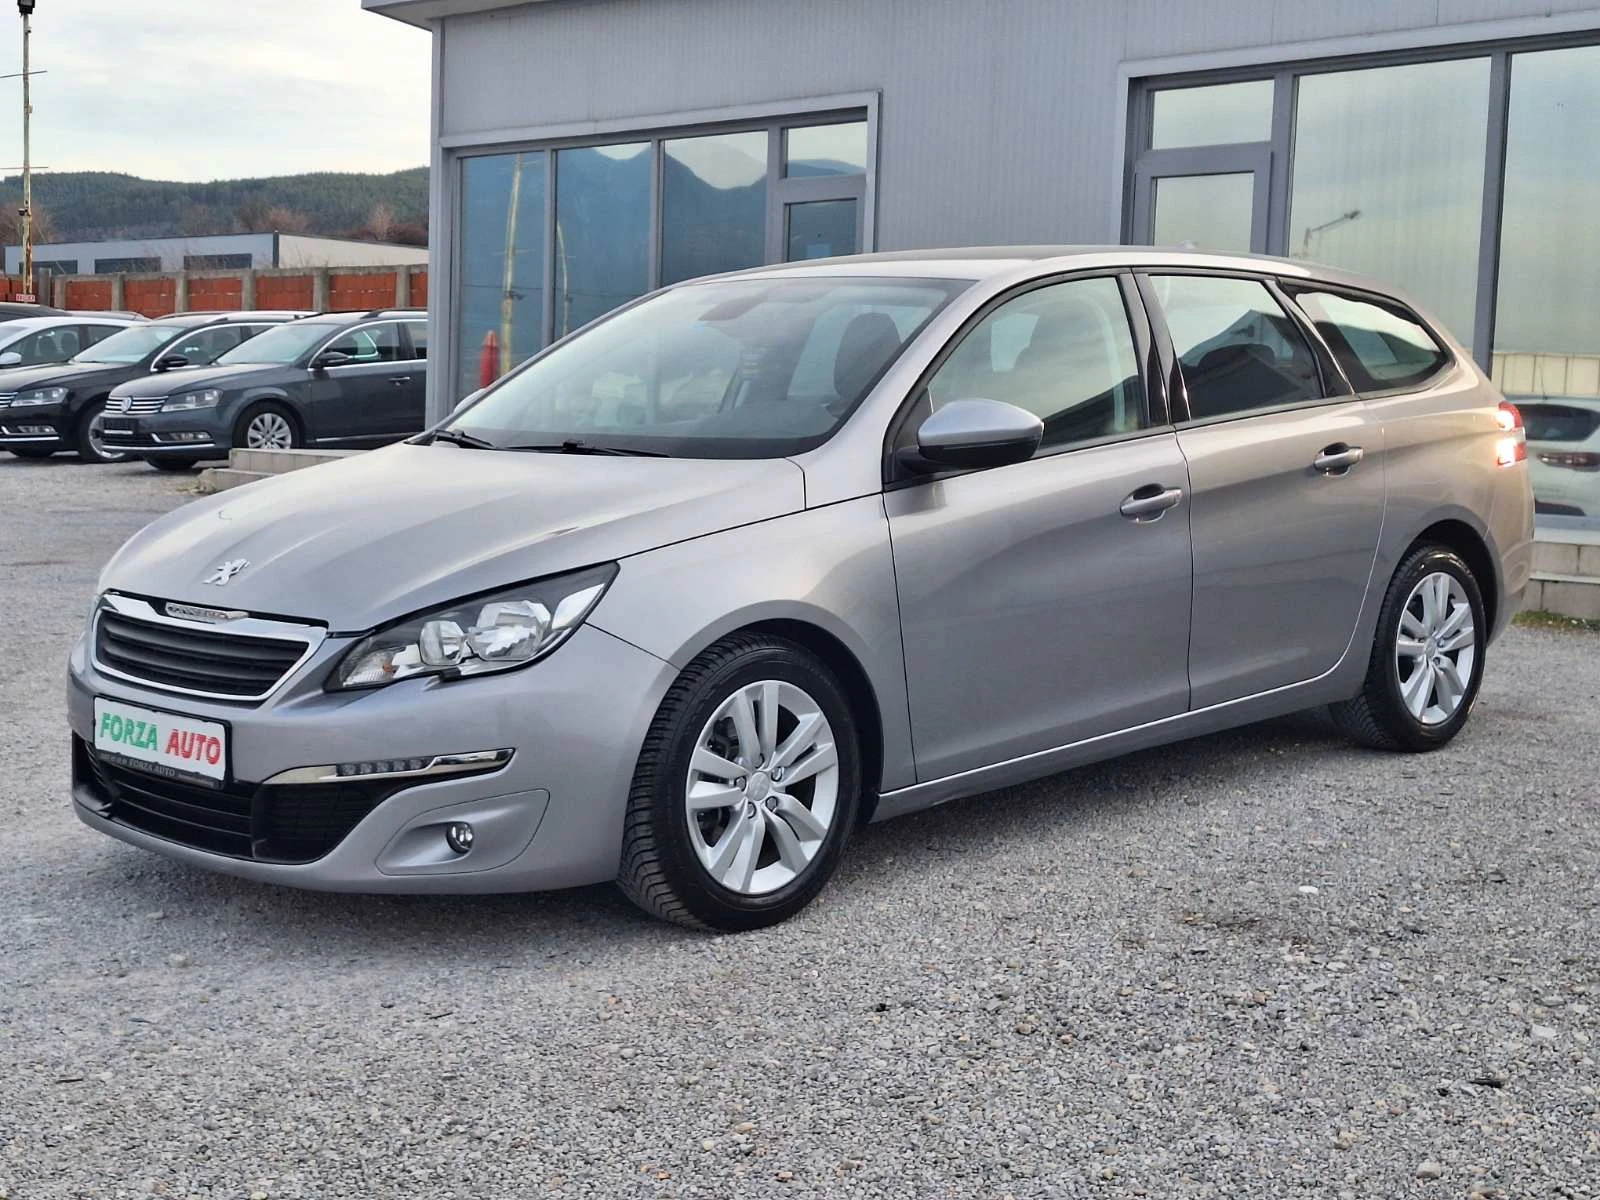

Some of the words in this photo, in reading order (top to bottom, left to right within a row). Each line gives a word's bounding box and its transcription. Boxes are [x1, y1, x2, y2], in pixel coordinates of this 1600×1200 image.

[100, 712, 158, 751] FORZA
[165, 729, 221, 765] AUTO
[154, 764, 176, 777] AUTO
